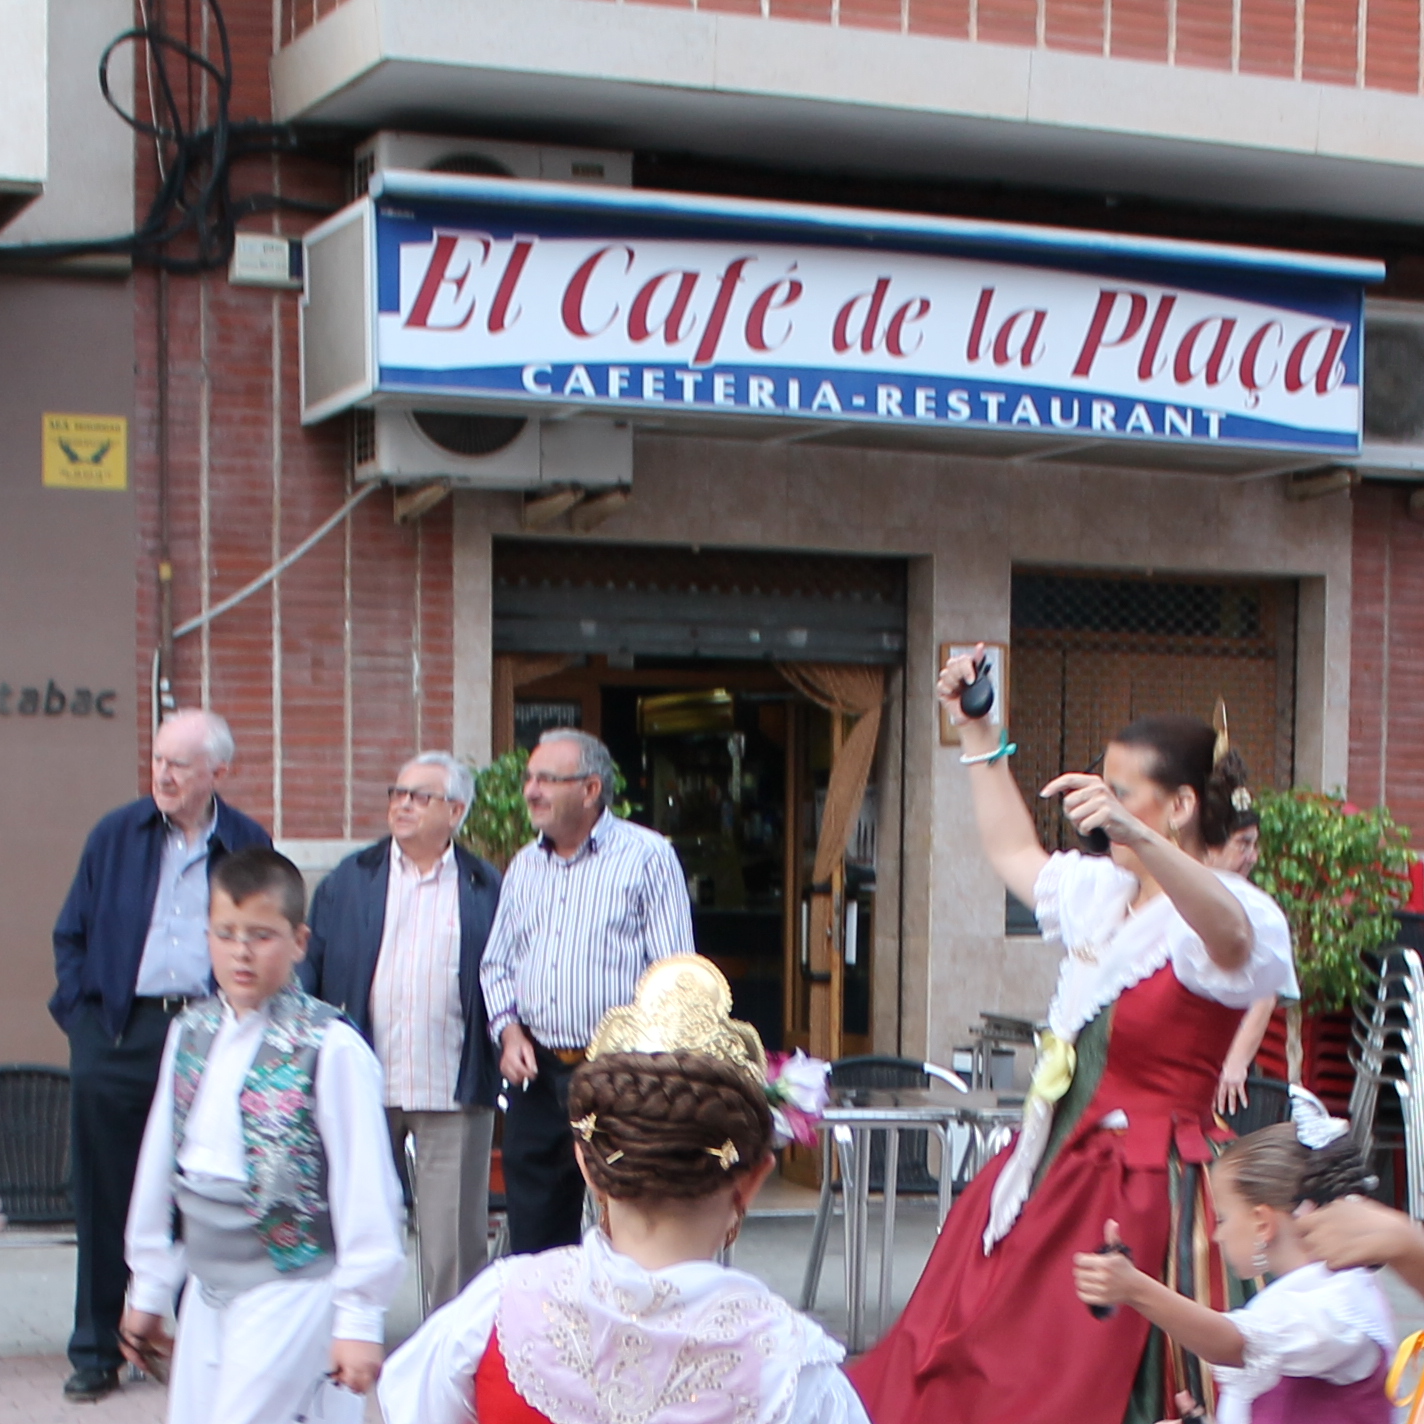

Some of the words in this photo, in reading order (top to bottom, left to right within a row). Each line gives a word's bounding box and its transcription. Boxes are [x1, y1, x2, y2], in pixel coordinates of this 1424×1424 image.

[403, 231, 536, 336] El
[560, 243, 804, 366] Café
[831, 276, 932, 358] de
[966, 286, 1049, 369] la
[1071, 288, 1350, 408] Plaça
[521, 363, 1226, 440] CAFETERIA-RESTAURANT
